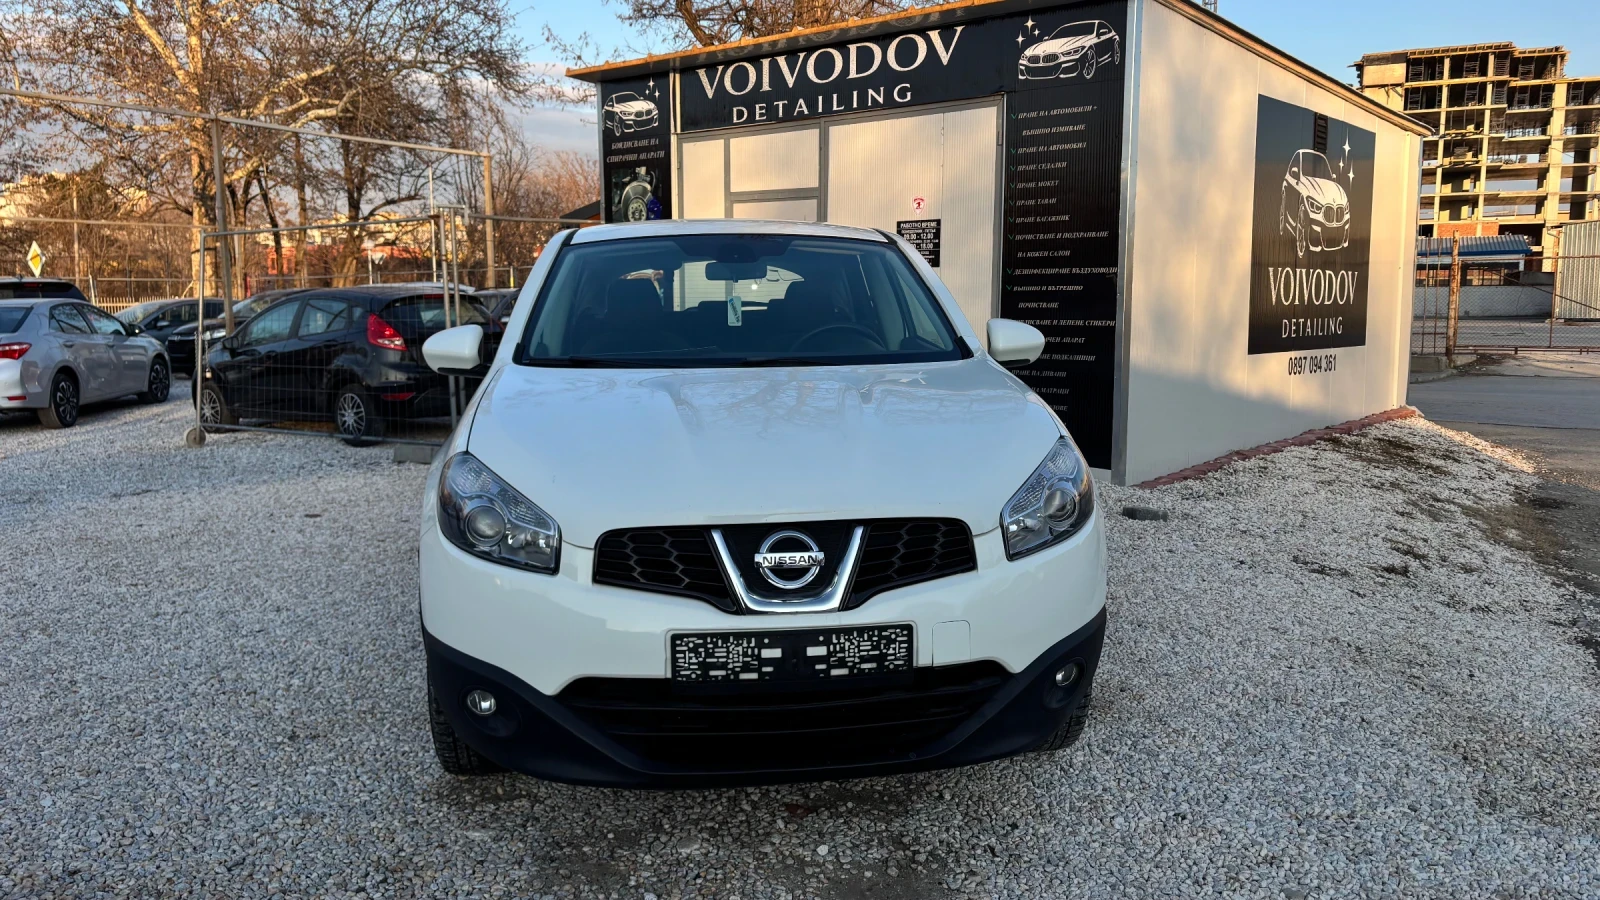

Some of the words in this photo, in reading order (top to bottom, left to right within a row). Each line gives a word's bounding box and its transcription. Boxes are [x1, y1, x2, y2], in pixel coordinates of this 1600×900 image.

[695, 25, 966, 100] VOIVODOV
[732, 83, 912, 124] DETAILING
[1018, 111, 1038, 119] ПРАНЕ
[1049, 105, 1093, 116] АВТОМОБИЛИ
[1051, 124, 1086, 134] ИЗМИВАНЕ
[650, 138, 659, 146] НА
[1048, 142, 1087, 151] АВТОМОБИЛ
[638, 150, 665, 160] АПАРАТИ
[1268, 267, 1358, 306] VOIVODOV
[1281, 316, 1343, 338] DETAILING
[1288, 356, 1308, 375] 0897
[1308, 355, 1322, 374] 094
[1323, 354, 1337, 372] 361
[762, 554, 818, 566] NISSAN
